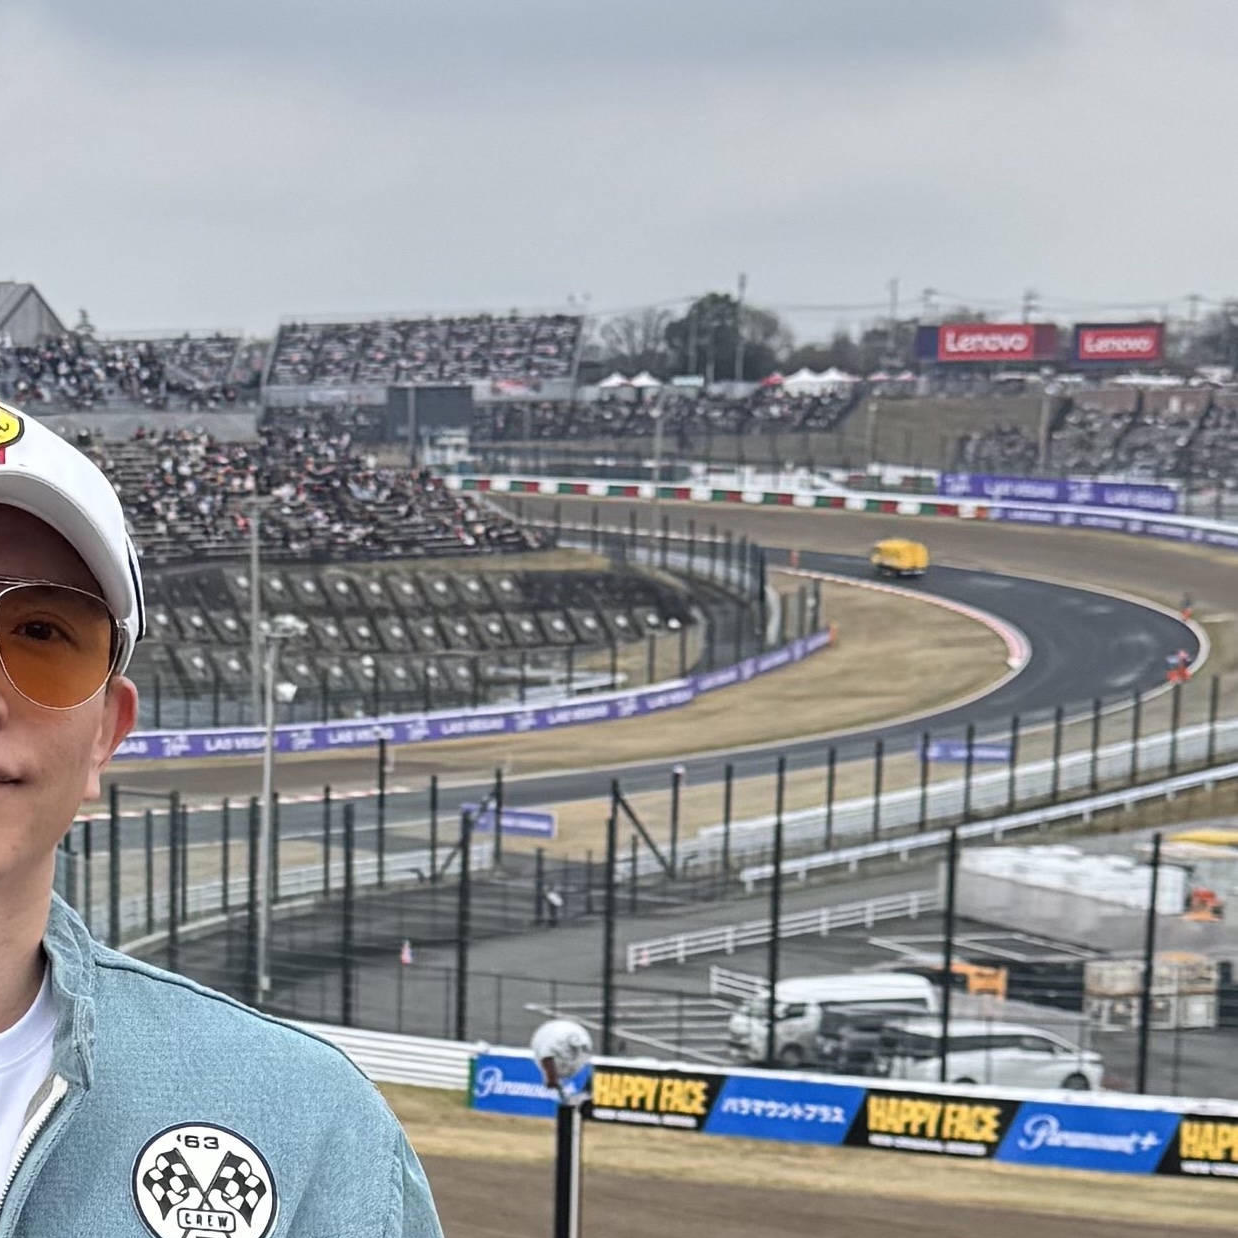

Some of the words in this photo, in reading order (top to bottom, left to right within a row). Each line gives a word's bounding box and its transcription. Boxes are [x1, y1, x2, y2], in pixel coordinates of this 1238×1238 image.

[945, 330, 1028, 352] Lenovo
[1083, 334, 1153, 352] Lenovo
[591, 1071, 660, 1112] HAPPY
[658, 1077, 709, 1115] FACE
[867, 1094, 942, 1139] HAPPY
[940, 1101, 999, 1143] FACE
[175, 1133, 220, 1150] '63
[184, 1212, 229, 1229] CREW
